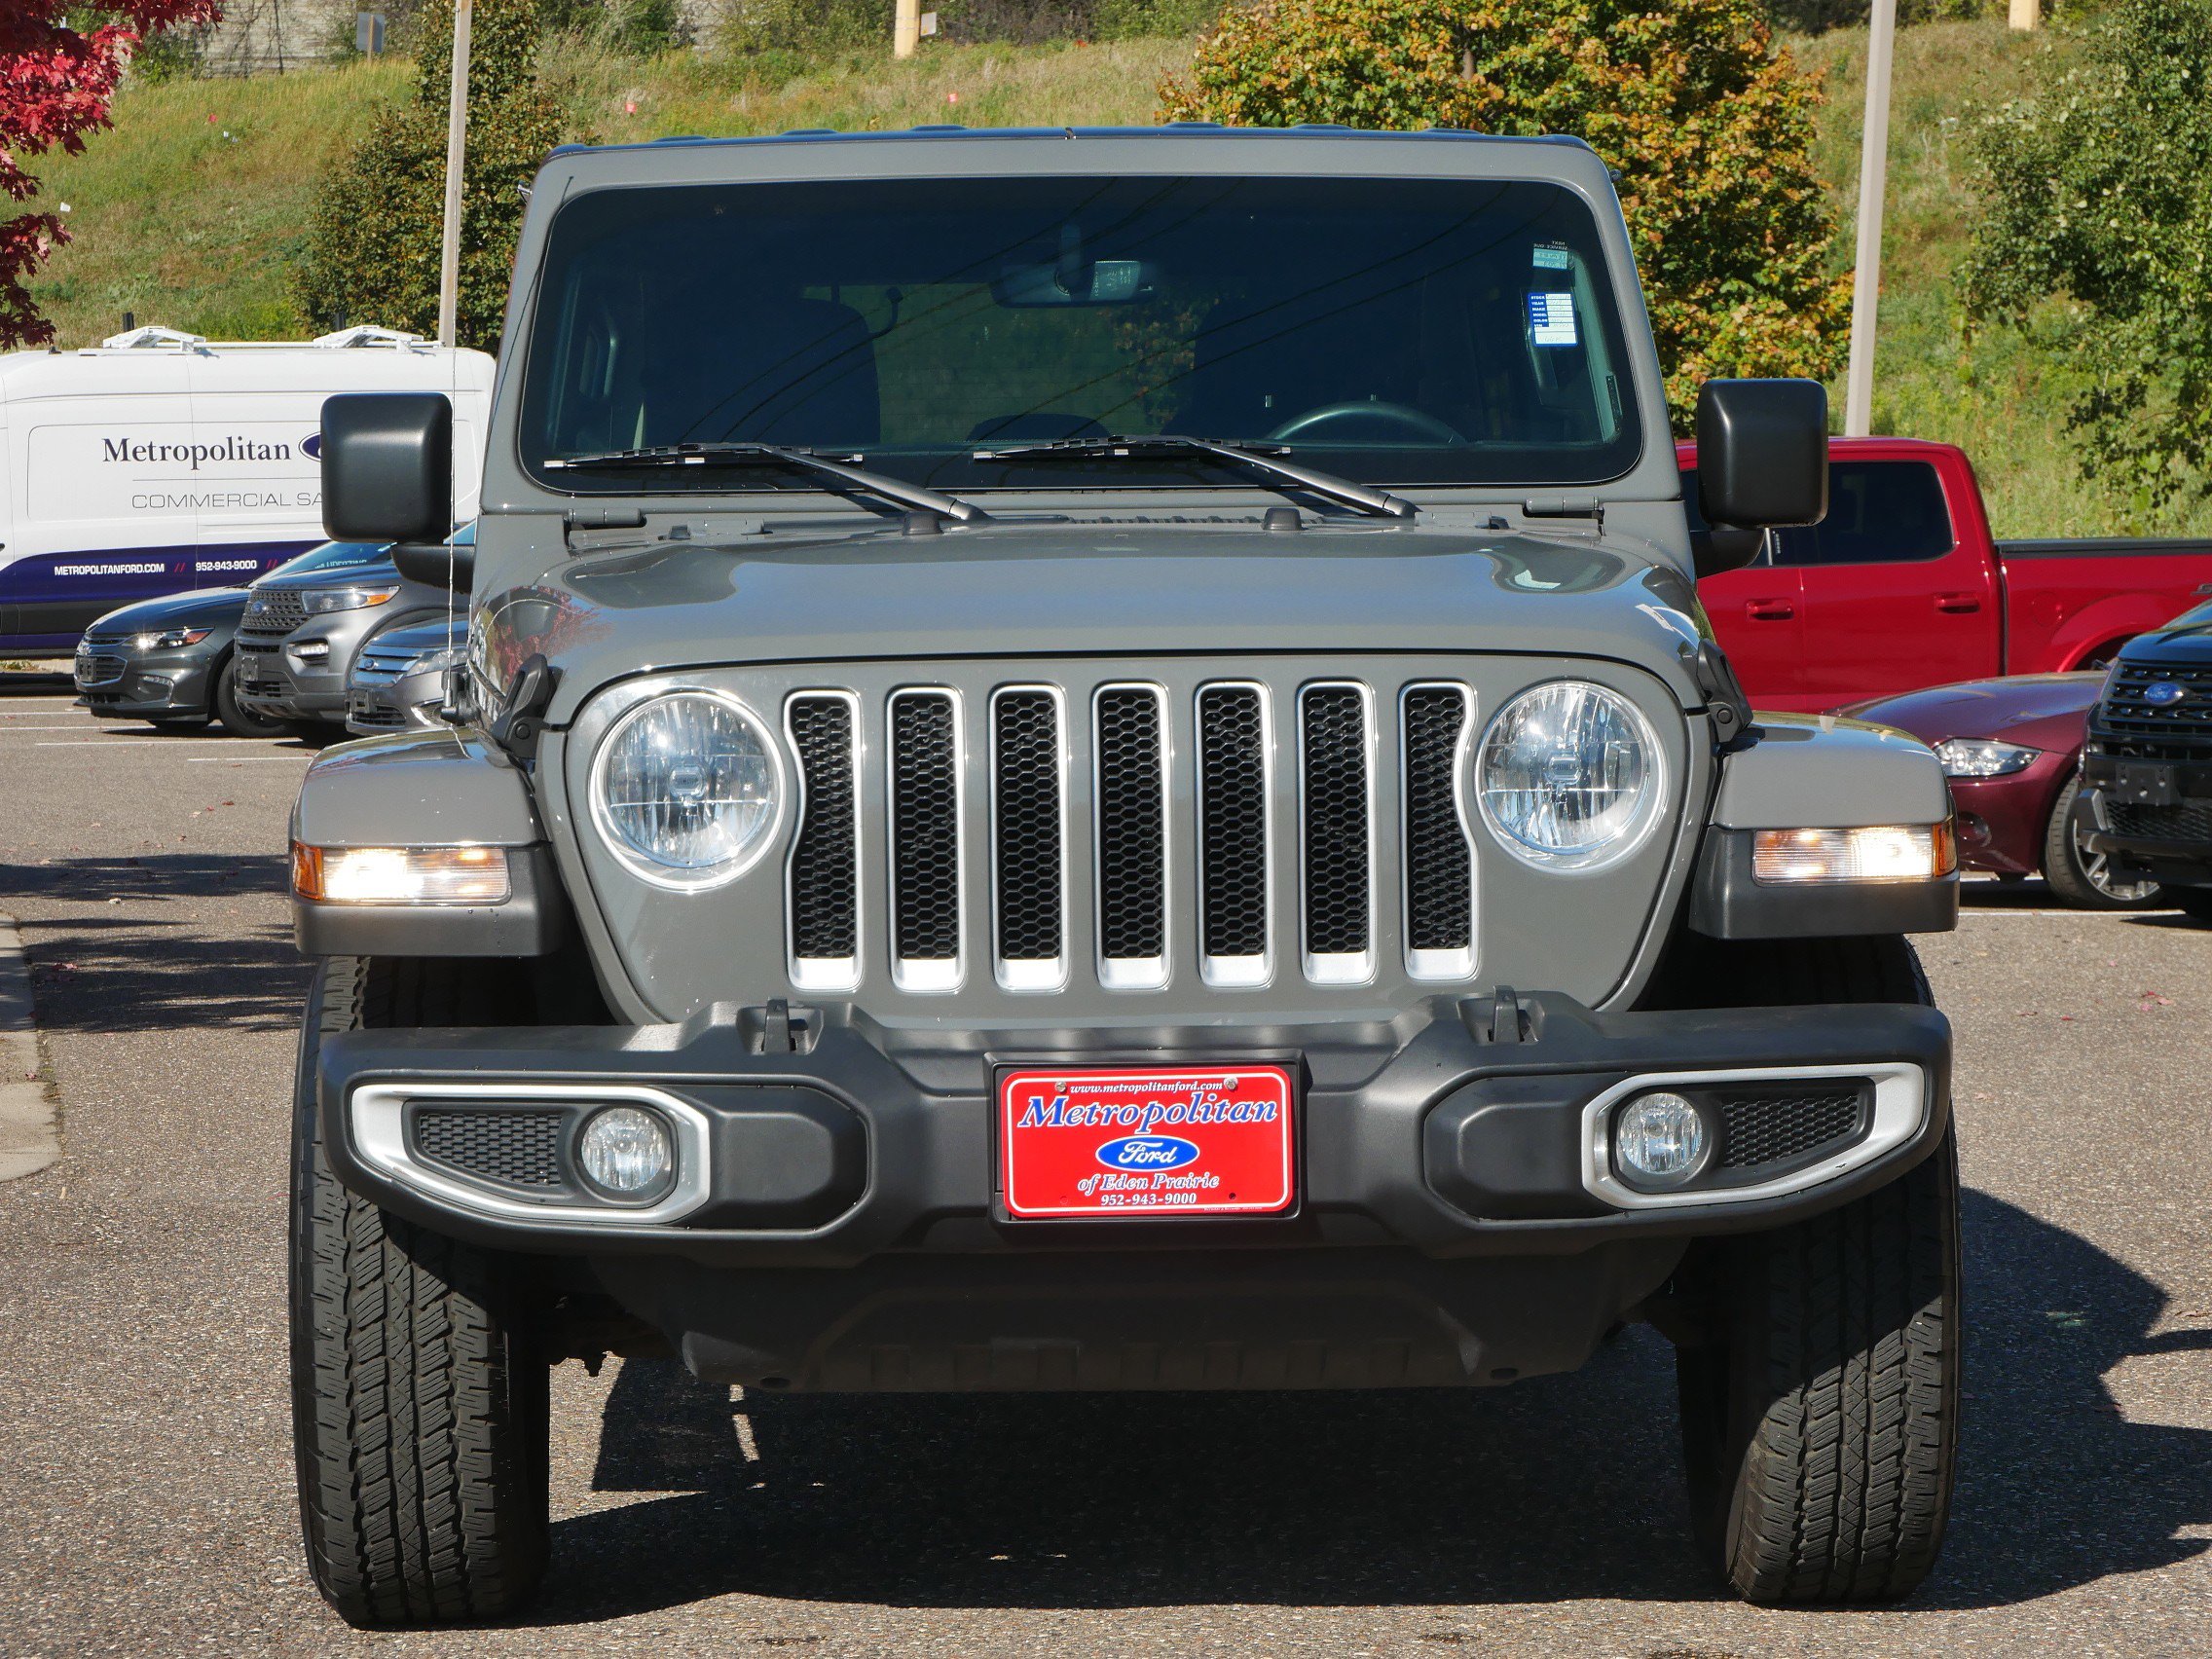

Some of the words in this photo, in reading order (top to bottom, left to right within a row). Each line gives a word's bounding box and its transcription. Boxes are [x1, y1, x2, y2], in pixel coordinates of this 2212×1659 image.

[102, 436, 292, 470] Metropolitan
[131, 493, 292, 509] COMMERCIAL
[297, 492, 322, 506] SA
[54, 563, 165, 576] METROPOLITANFORD.COM
[195, 559, 257, 571] 952-943-9000
[1070, 1081, 1223, 1094] www.metropolitanford.com
[1017, 1091, 1277, 1134] Metropolitan
[1118, 1141, 1177, 1164] Ford
[1078, 1174, 1100, 1195] of
[1102, 1174, 1149, 1191] Eden
[1153, 1172, 1219, 1190] Prairie
[1100, 1193, 1197, 1206] 952-943-9000
